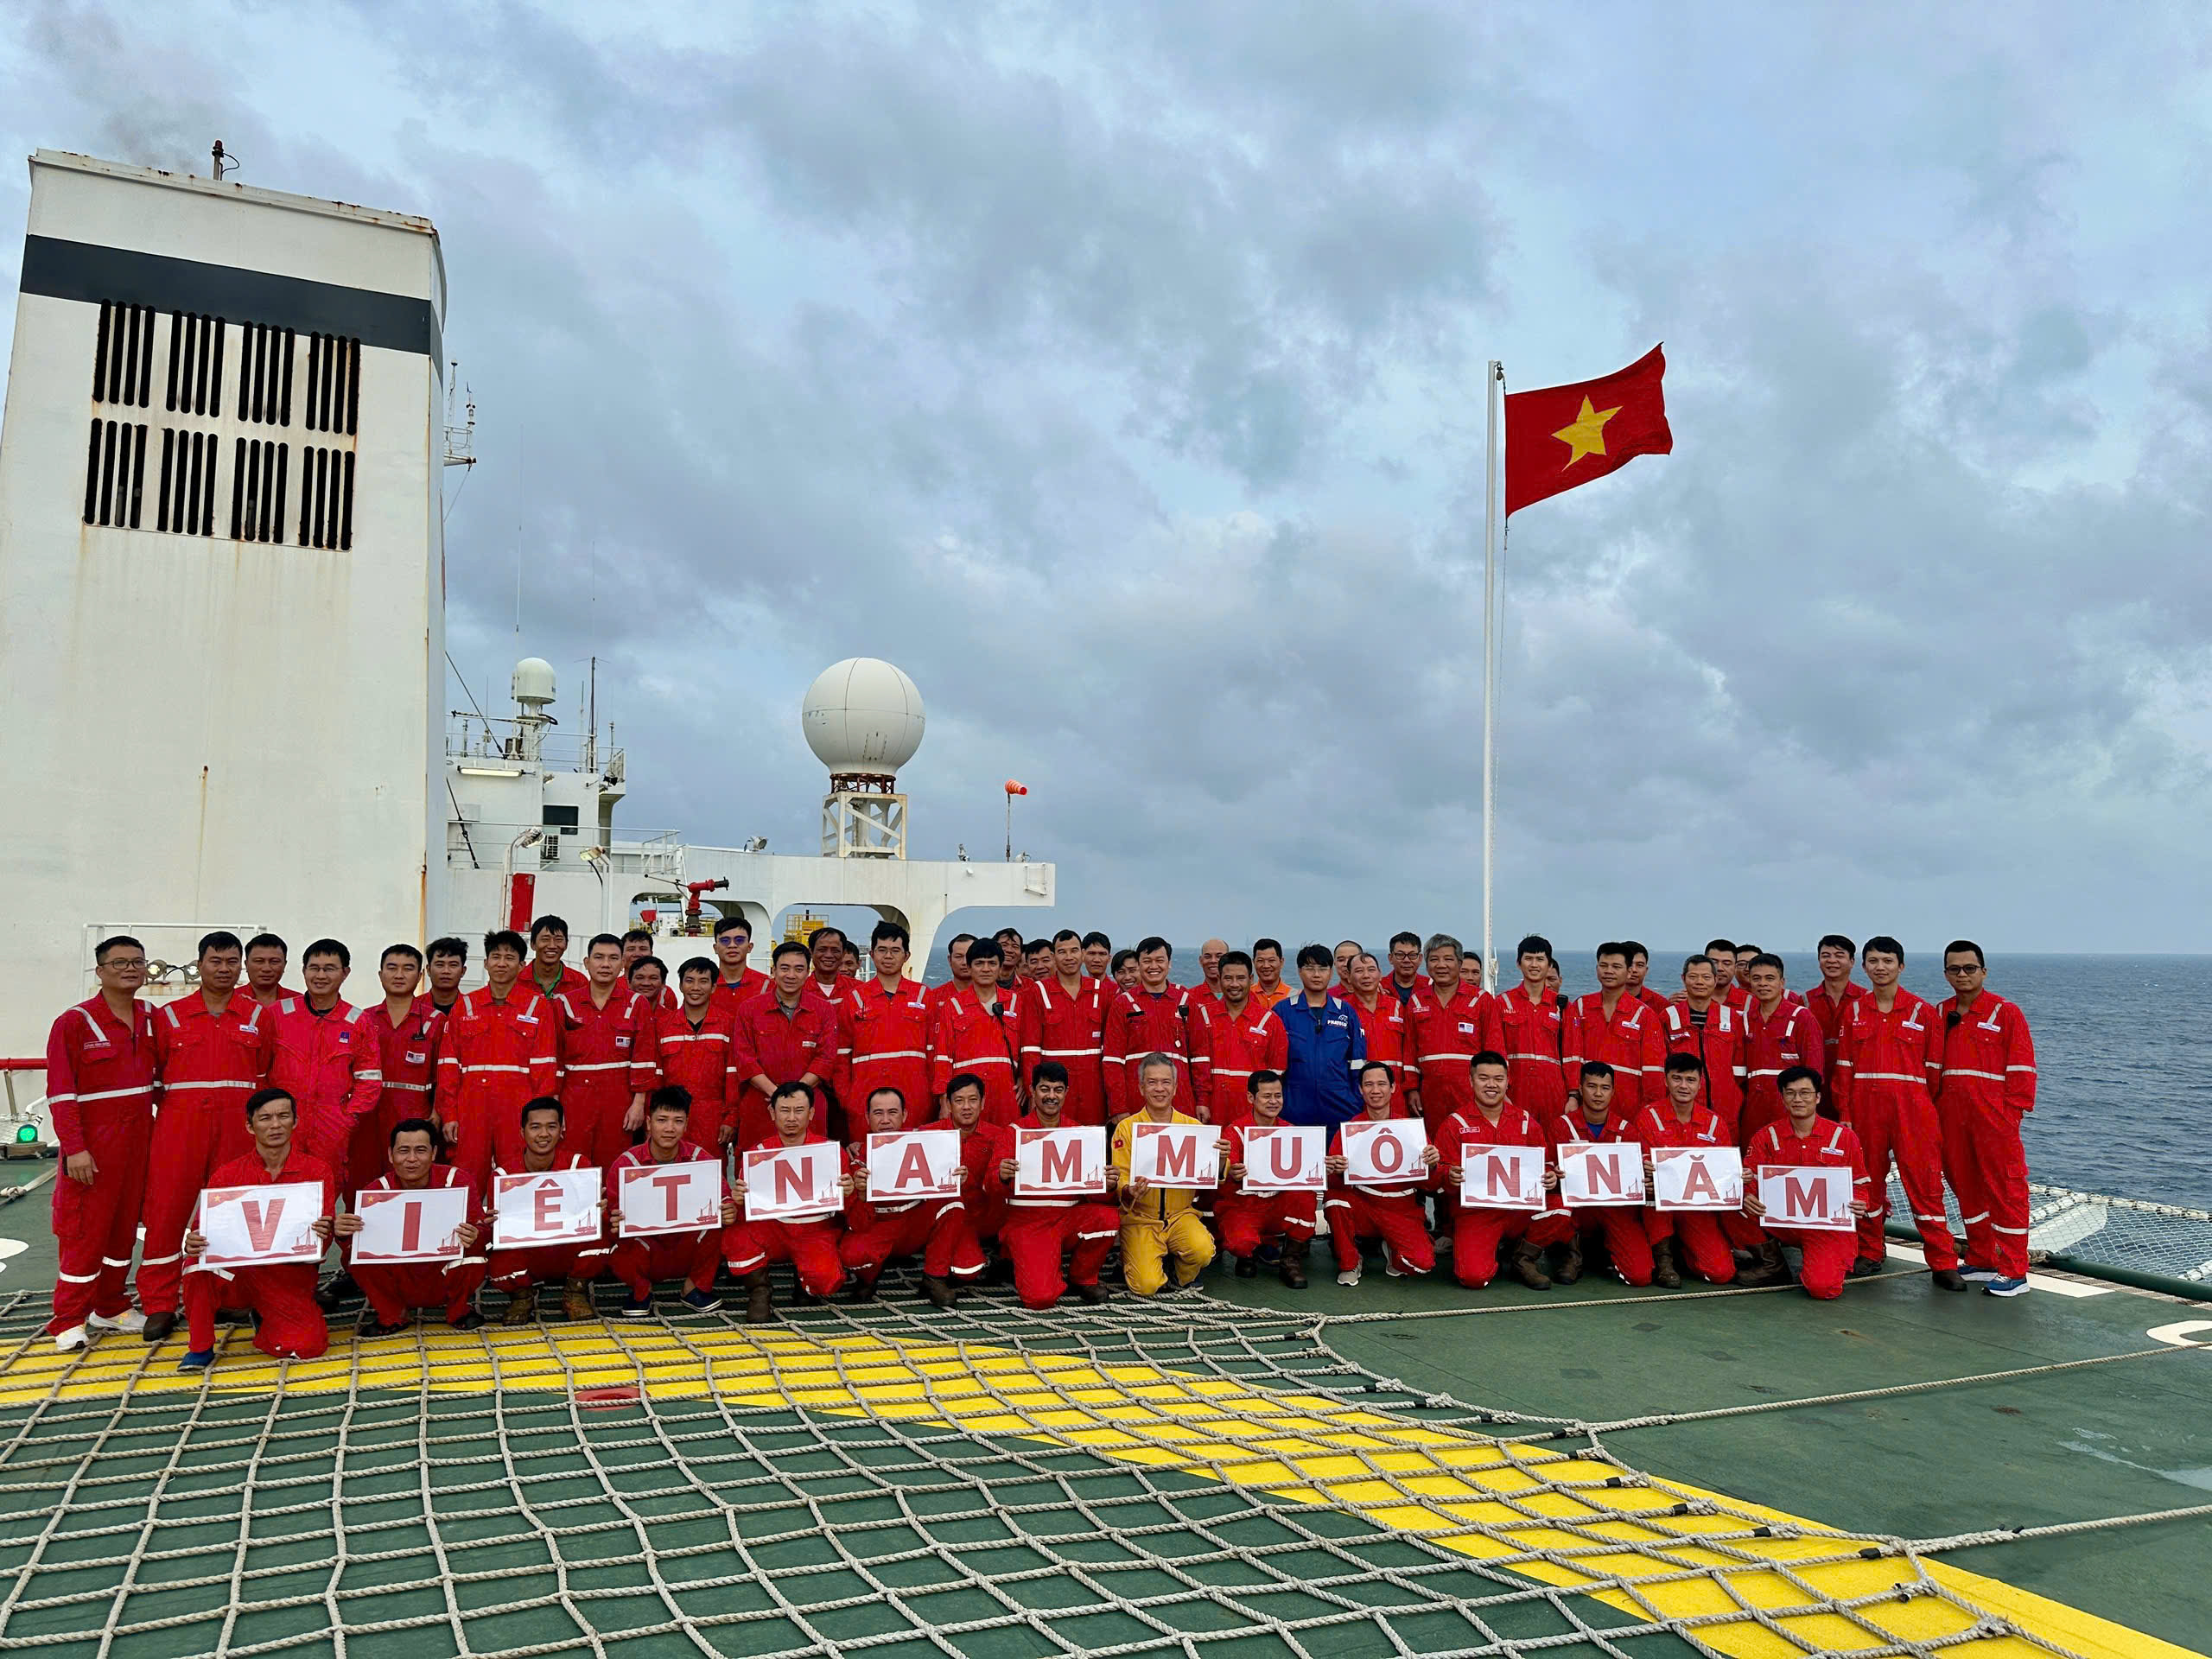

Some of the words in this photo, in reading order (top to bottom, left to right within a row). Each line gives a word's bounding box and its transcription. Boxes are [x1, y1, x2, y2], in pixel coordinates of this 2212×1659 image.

[895, 1142, 934, 1188] A
[1041, 1139, 1082, 1183] M
[1156, 1135, 1197, 1178] M
[1270, 1136, 1303, 1179] U
[1371, 1128, 1403, 1174] Ô
[1586, 1154, 1622, 1194] N
[652, 1174, 691, 1222] T
[774, 1156, 814, 1205] N
[1487, 1155, 1520, 1198] N
[1681, 1154, 1718, 1200] Ă
[1785, 1177, 1828, 1217] M
[241, 1199, 287, 1252] V
[401, 1202, 423, 1251] I
[534, 1178, 563, 1231] Ê
